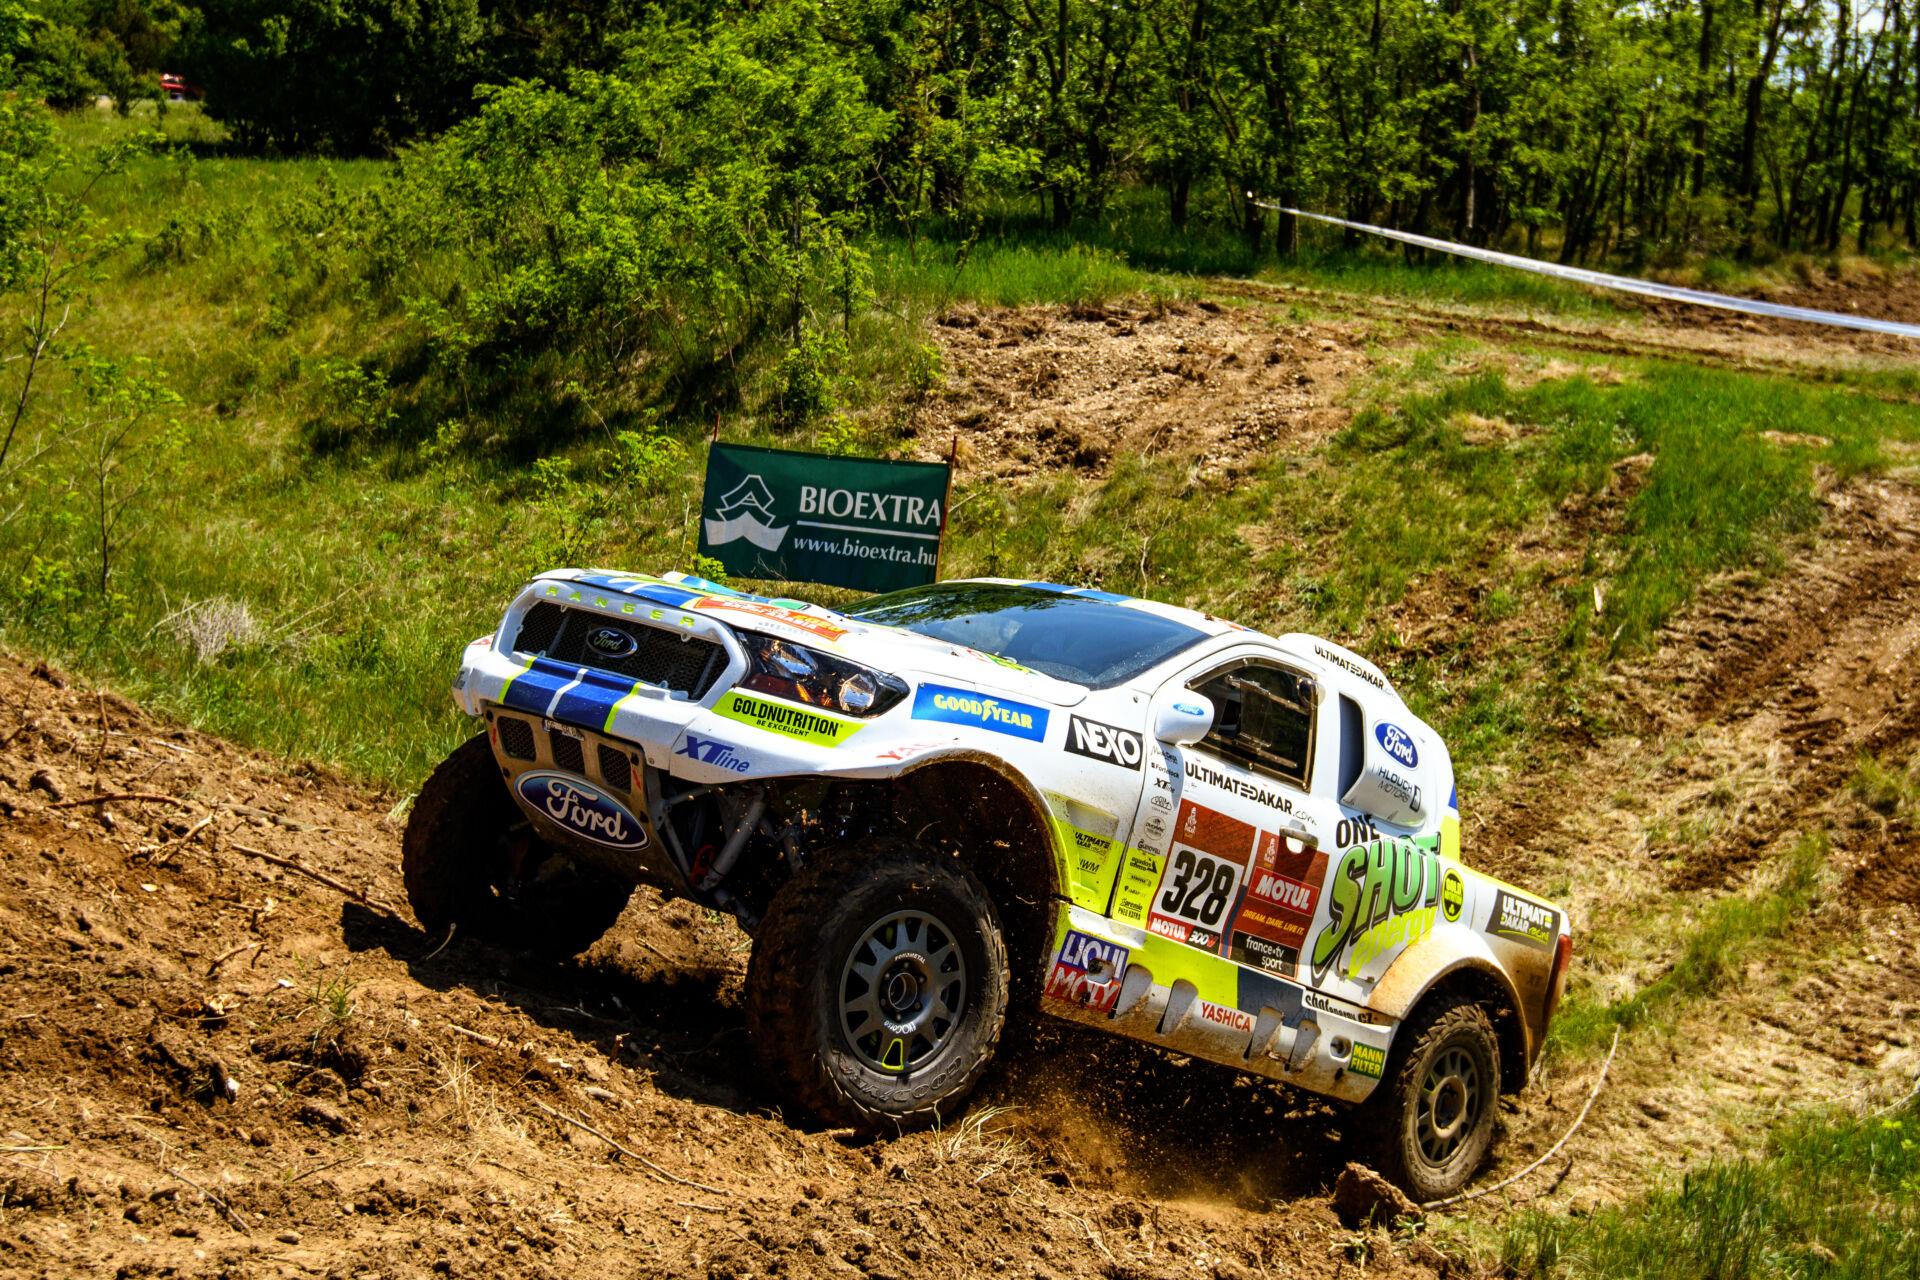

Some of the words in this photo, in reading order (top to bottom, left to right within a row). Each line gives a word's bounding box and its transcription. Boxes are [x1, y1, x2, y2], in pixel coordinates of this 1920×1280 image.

[799, 485, 942, 527] BIOEXTRA
[793, 536, 937, 567] www.bioextra.hu
[545, 585, 695, 629] RANGER
[593, 629, 624, 651] Ford
[934, 693, 1033, 730] GOODYEAR
[1175, 702, 1202, 716] Ford
[756, 718, 766, 728] BE
[767, 721, 810, 737] EXCELLENT
[1074, 717, 1141, 767] NEXO
[1383, 724, 1415, 765] Ford
[674, 734, 750, 773] XTline
[1377, 766, 1413, 793] HLOUCH
[545, 777, 630, 842] Ford
[1335, 813, 1381, 849] ONE
[1160, 849, 1236, 927] 328
[1255, 873, 1312, 911] MOTUL
[1310, 831, 1442, 988] SHOT
[1500, 912, 1530, 934] DAKAR
[1502, 894, 1553, 929] ULTIMATE
[1150, 916, 1187, 941] MOTUL
[1188, 930, 1219, 948] 300V
[1347, 906, 1439, 981] energy
[1261, 954, 1283, 971] sport
[1200, 1001, 1252, 1033] YASHICA
[1350, 1056, 1381, 1077] FILTER
[1352, 1043, 1384, 1064] MANN
